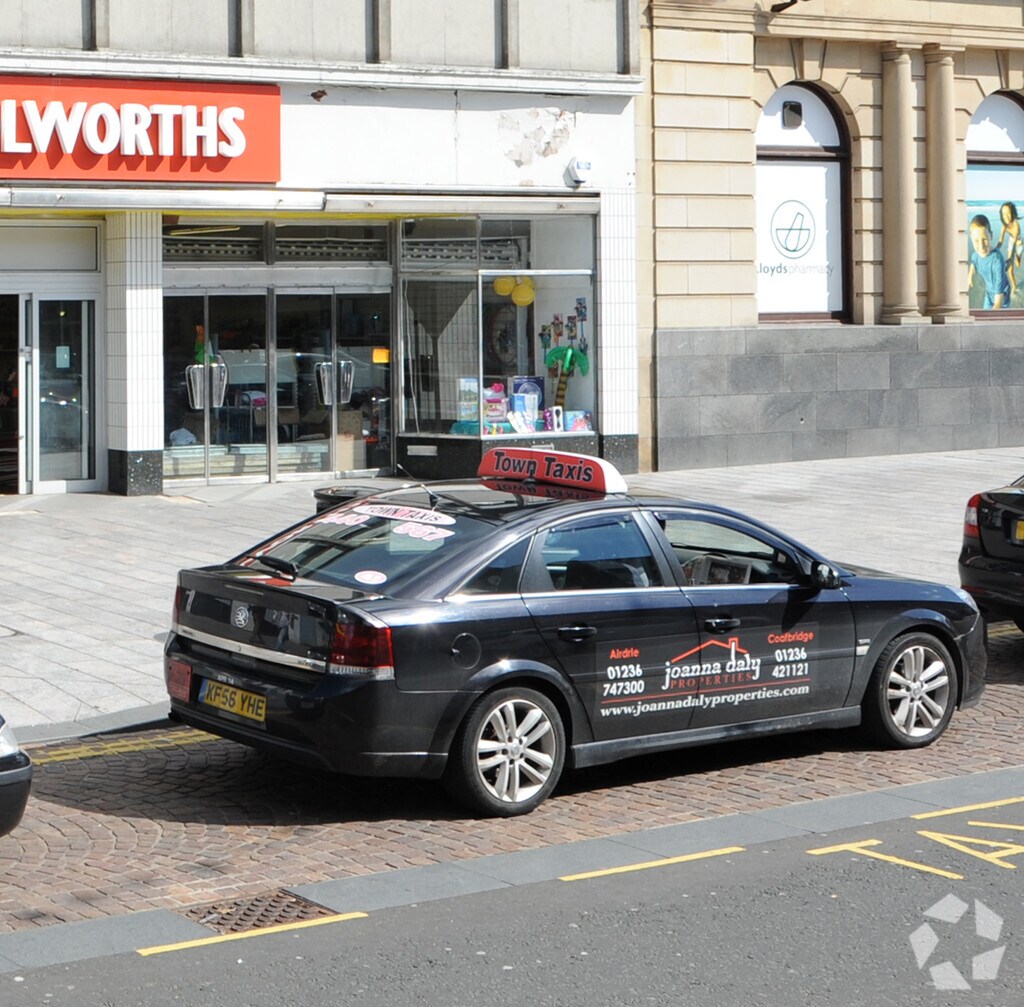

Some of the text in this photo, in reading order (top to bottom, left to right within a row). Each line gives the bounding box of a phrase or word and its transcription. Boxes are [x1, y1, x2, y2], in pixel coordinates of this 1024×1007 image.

[494, 451, 594, 482] Town Taxis
[609, 648, 640, 659] Airdrie
[775, 647, 807, 662] 01236
[607, 664, 643, 680] 01236
[661, 641, 761, 690] joanna daly
[772, 663, 808, 678] 421121
[603, 680, 645, 696] 747300
[670, 673, 752, 689] PROPERTIES
[241, 693, 265, 717] YHE
[600, 685, 809, 717] www.joannadalyproperties.com
